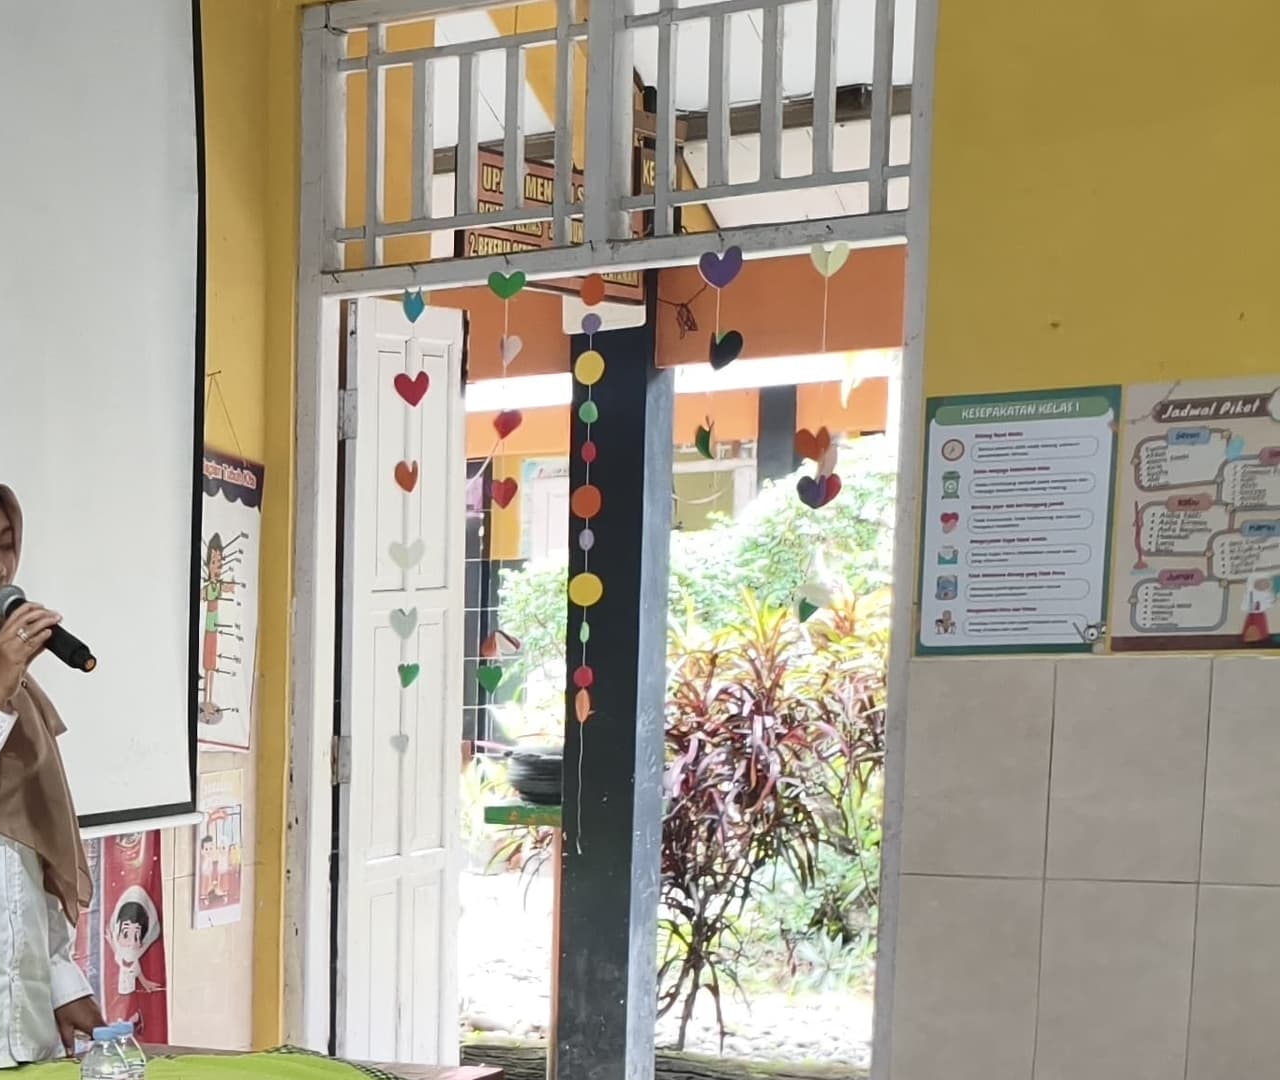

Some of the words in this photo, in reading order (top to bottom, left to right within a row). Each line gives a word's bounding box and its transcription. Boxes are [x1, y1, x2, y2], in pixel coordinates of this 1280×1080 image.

[962, 404, 1036, 419] KESEPAKATAN
[1038, 401, 1073, 416] KELAS
[1161, 401, 1217, 419] Jadwal
